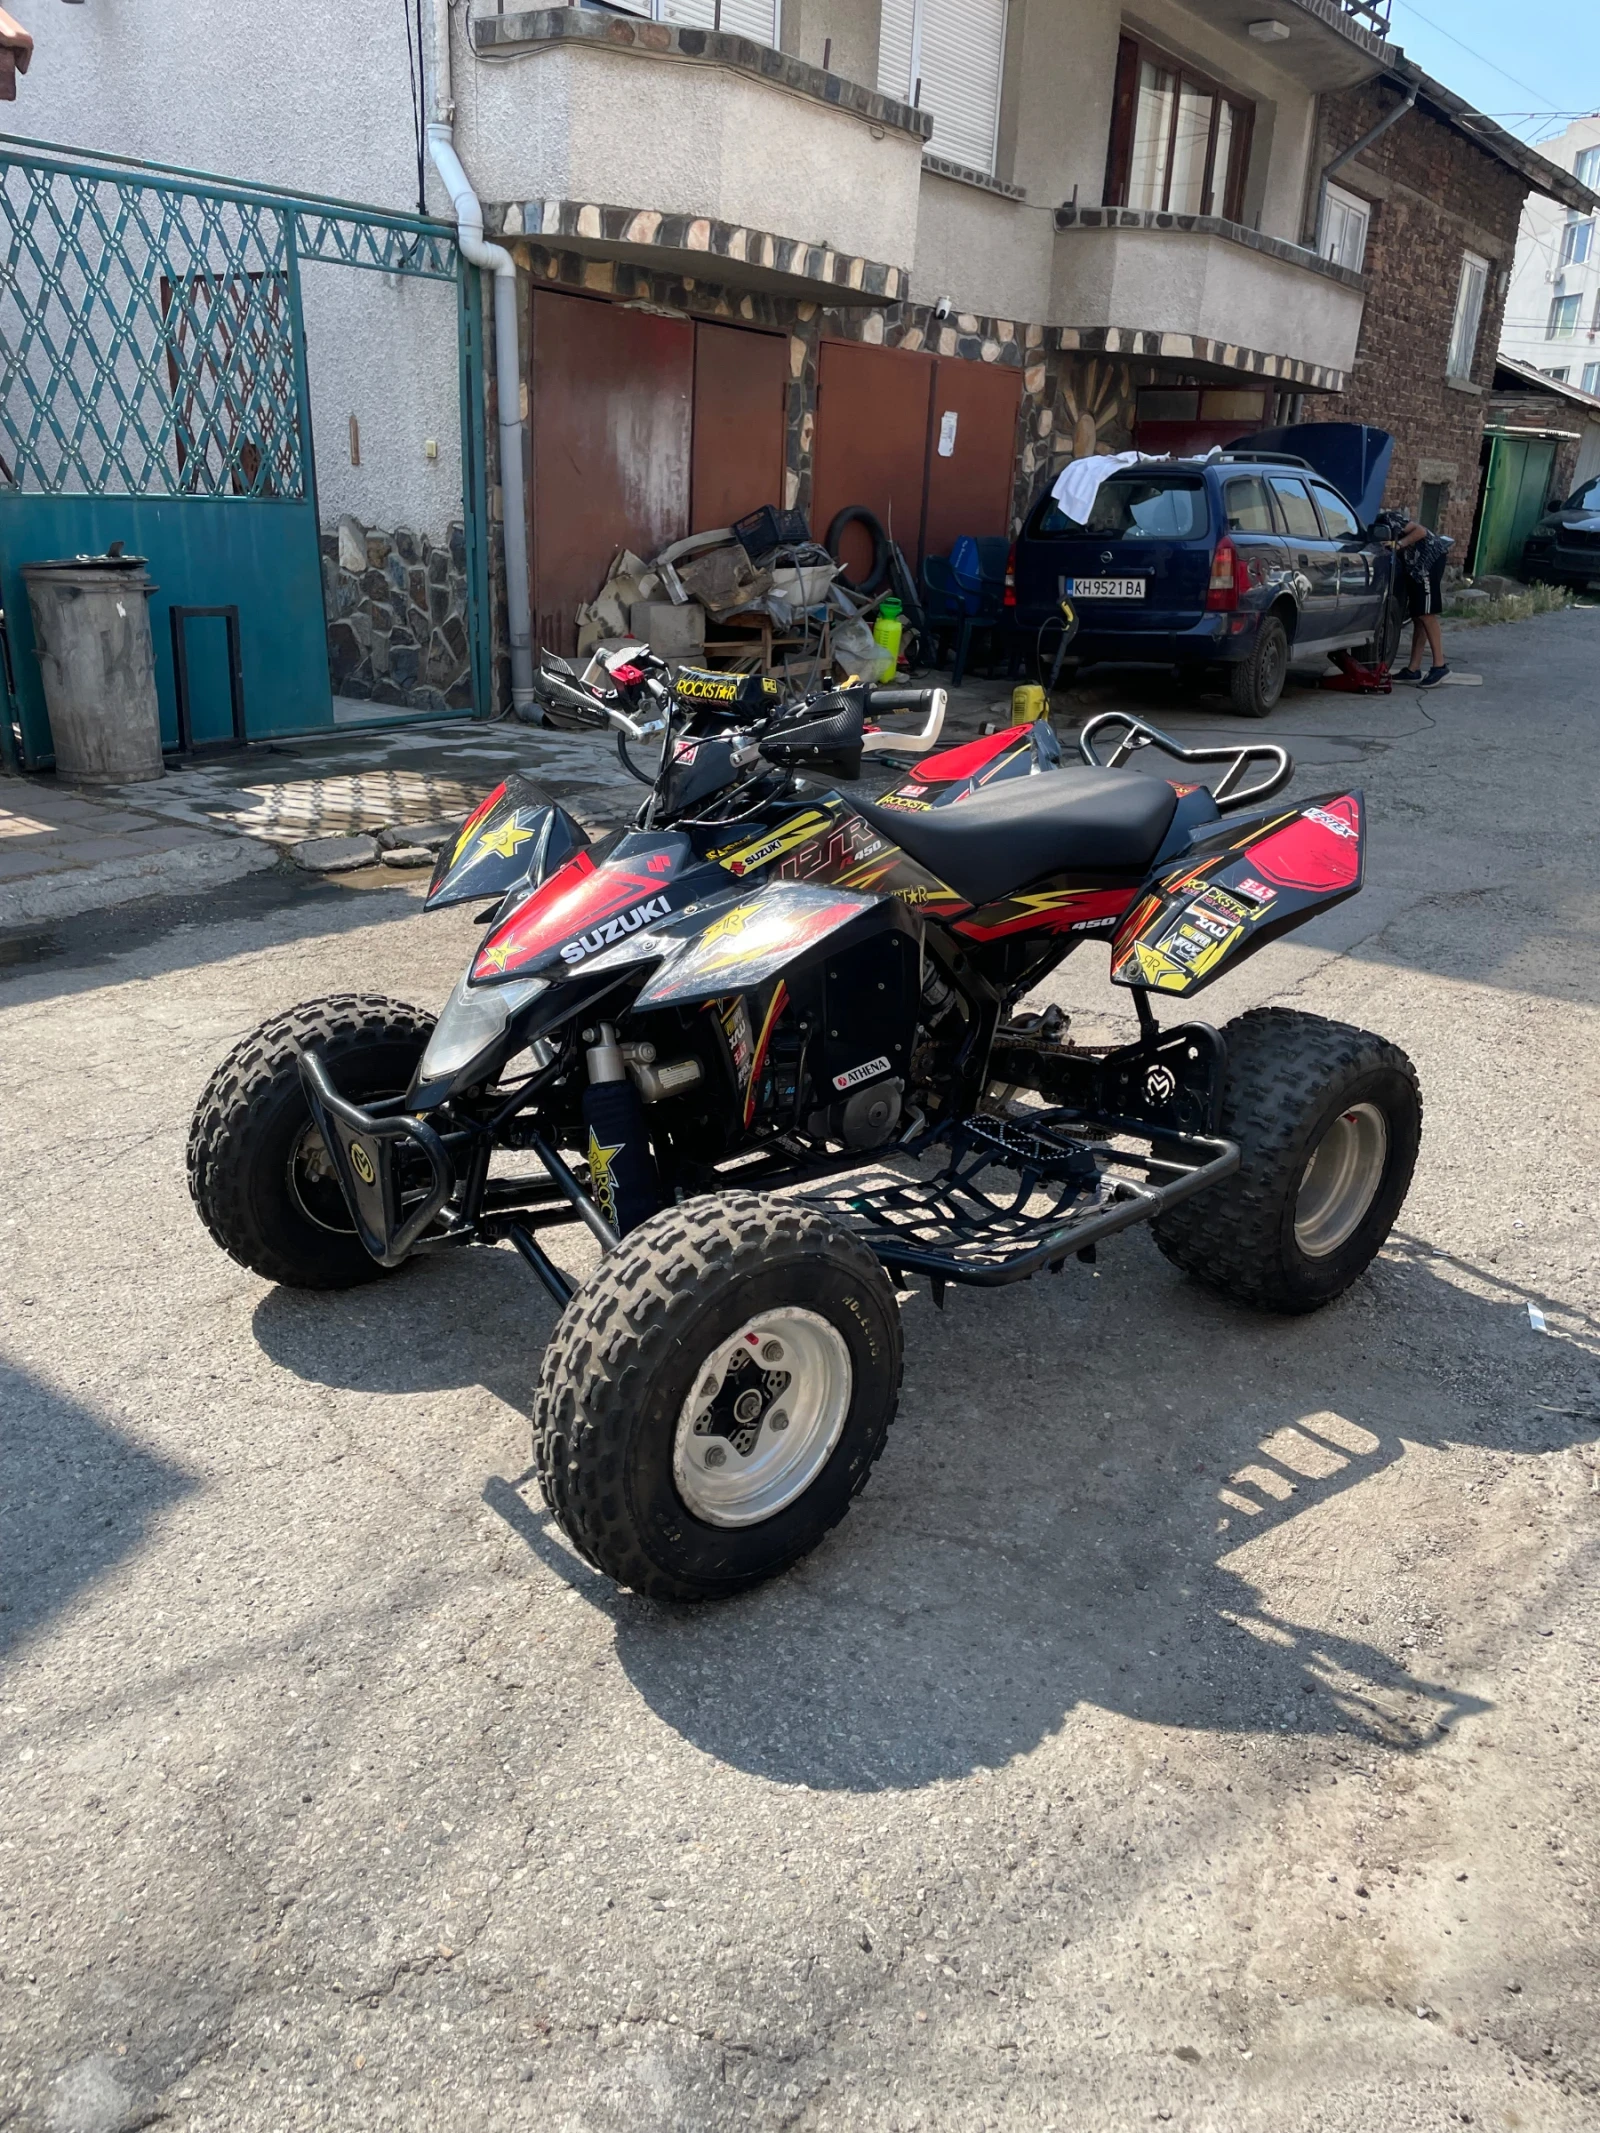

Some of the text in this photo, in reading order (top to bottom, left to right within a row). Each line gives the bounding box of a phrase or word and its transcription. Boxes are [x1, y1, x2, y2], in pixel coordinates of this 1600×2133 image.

[883, 796, 933, 811] ROCKSTA
[744, 840, 782, 866] SUZUKI
[560, 895, 672, 965] SUZUKI
[847, 1059, 888, 1083] ATHENA
[842, 1296, 880, 1366] HOLEO
